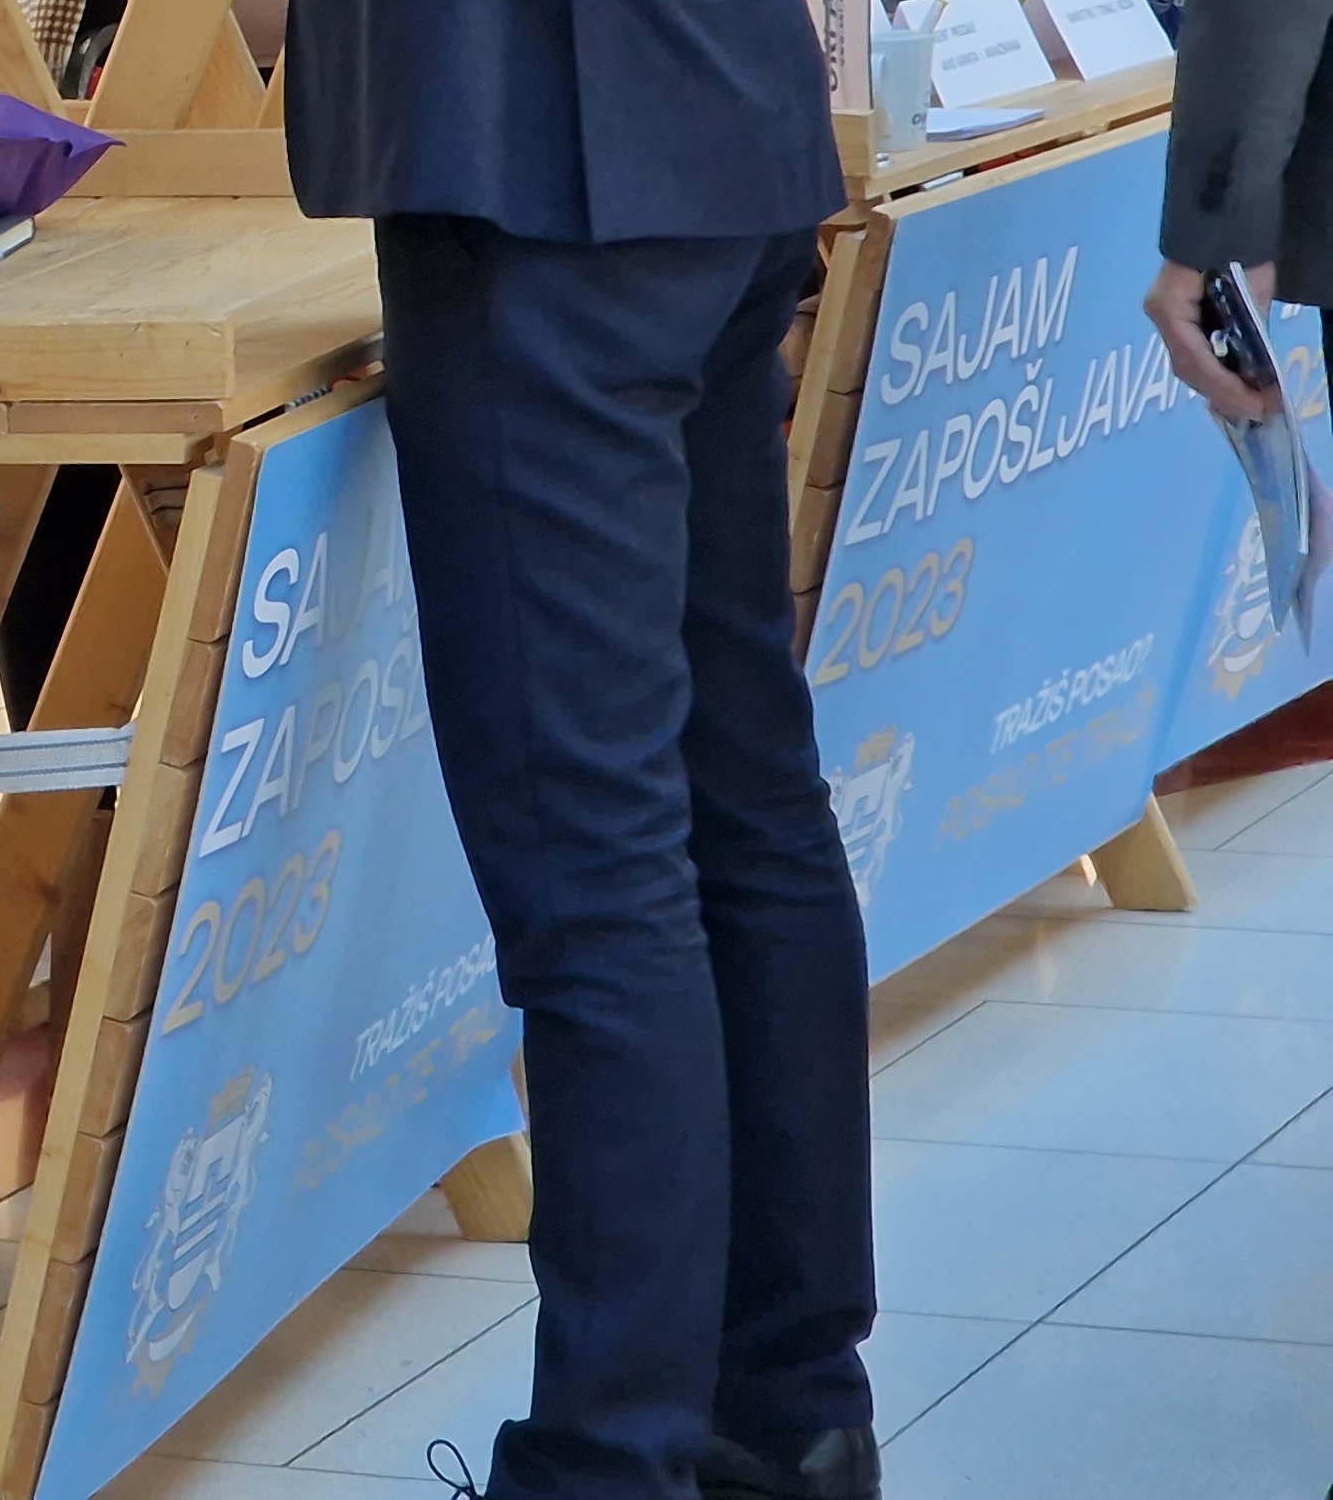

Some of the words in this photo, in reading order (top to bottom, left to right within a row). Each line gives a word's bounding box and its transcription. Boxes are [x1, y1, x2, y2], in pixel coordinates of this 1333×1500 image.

[880, 245, 1078, 405] SAJAM
[814, 537, 974, 687] 2023
[990, 667, 1071, 755] TRAŽIŠ
[161, 828, 342, 1037] 2023
